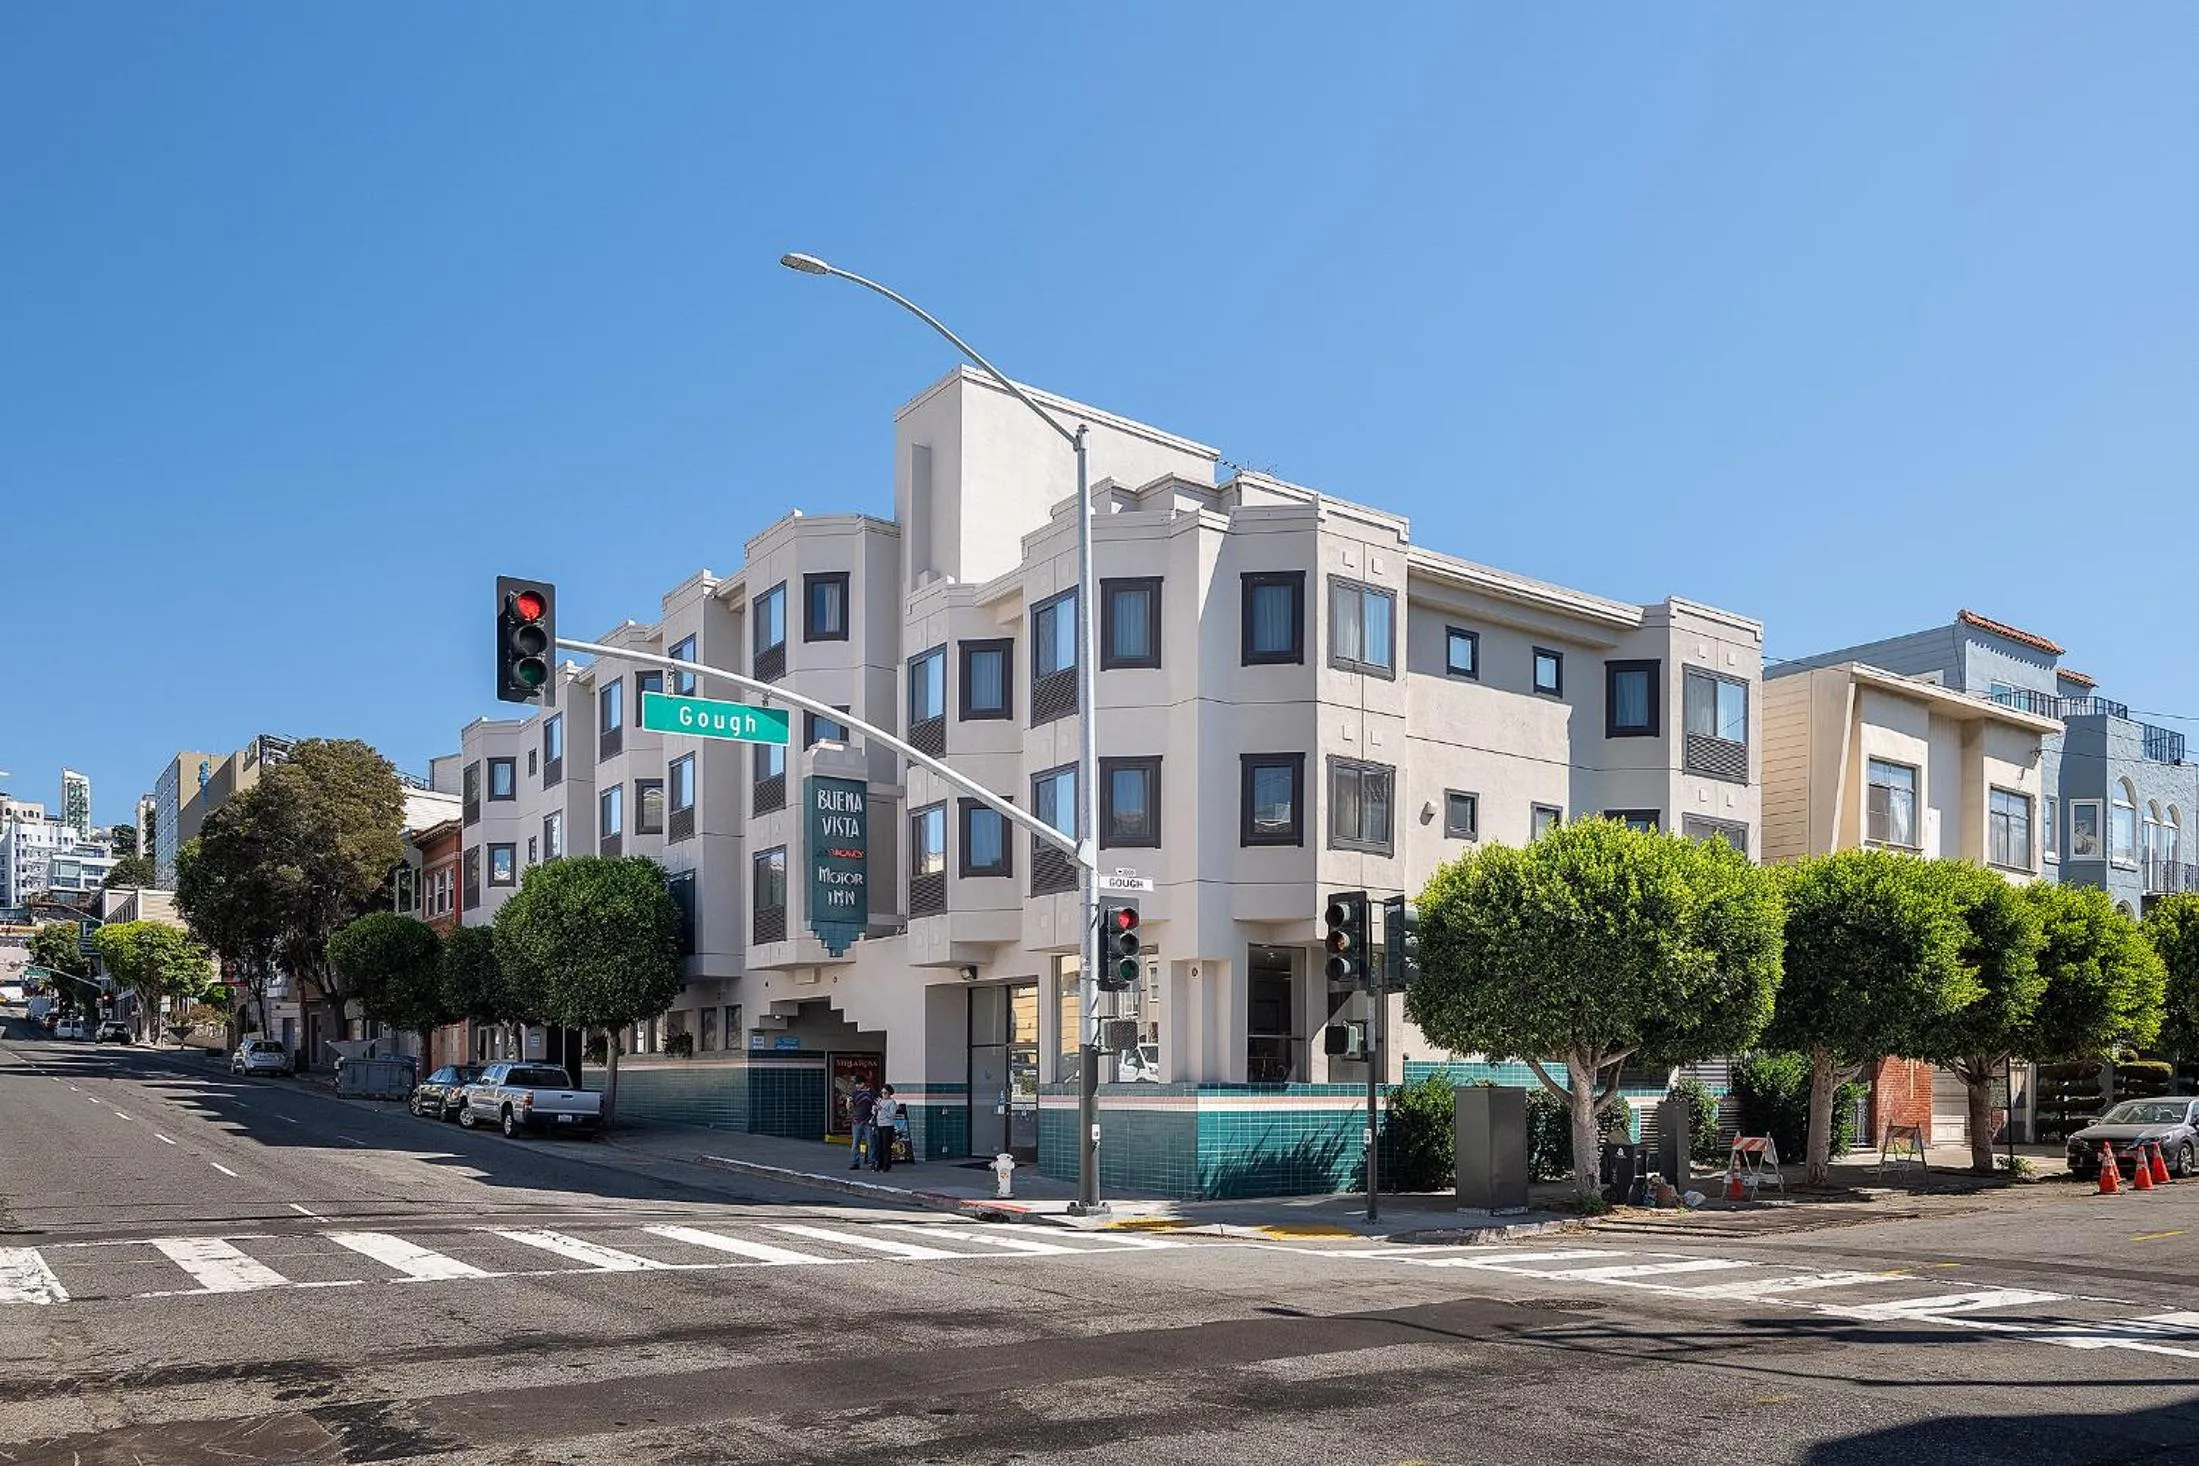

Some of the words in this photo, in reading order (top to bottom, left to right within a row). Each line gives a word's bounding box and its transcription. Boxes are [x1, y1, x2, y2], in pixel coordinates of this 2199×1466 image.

[679, 705, 756, 737] Gough
[817, 789, 863, 813] BUENA
[821, 815, 860, 838] VISTA
[818, 866, 863, 885] MOTOR
[1109, 877, 1144, 889] GOUGH
[827, 889, 856, 906] INN
